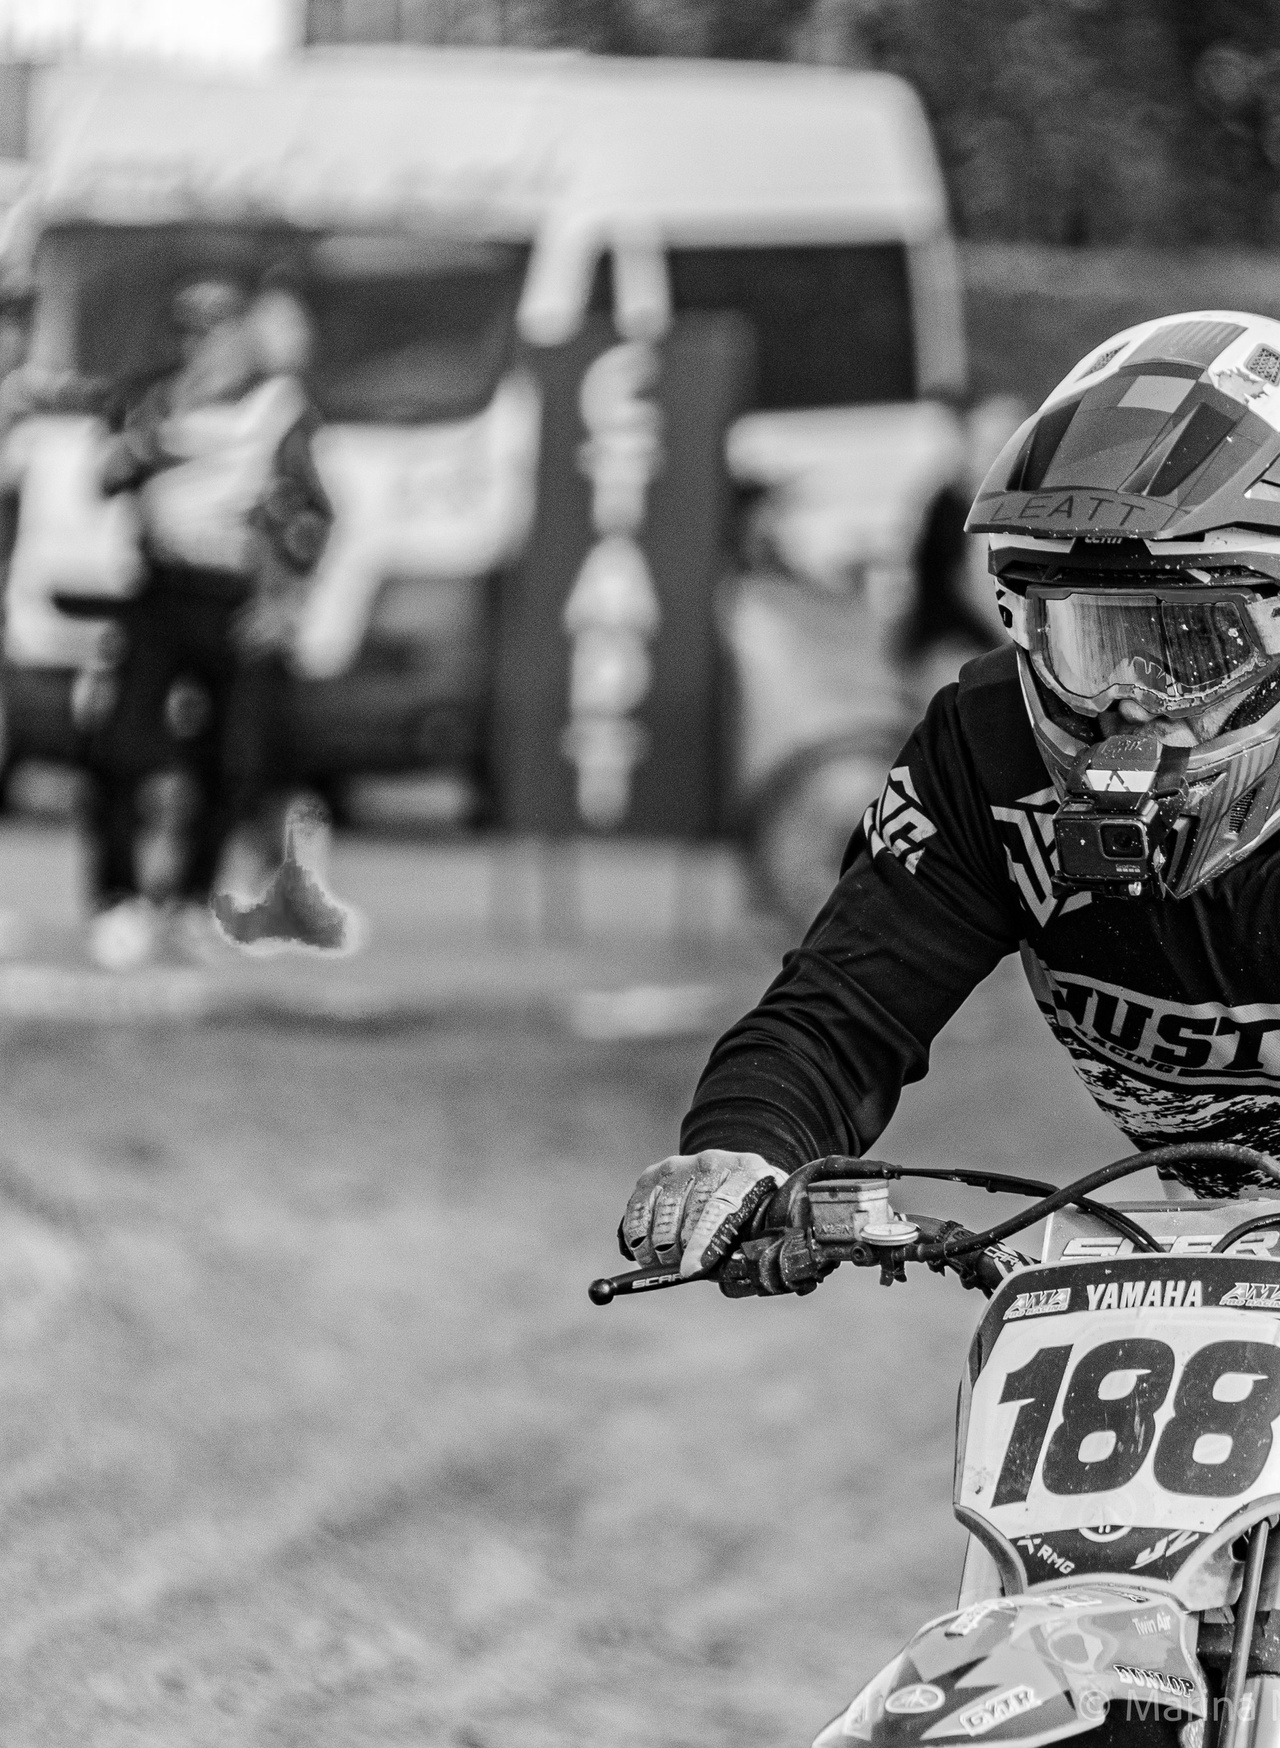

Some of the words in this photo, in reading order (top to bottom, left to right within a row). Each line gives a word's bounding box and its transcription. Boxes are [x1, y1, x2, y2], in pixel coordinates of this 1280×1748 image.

[989, 495, 1146, 527] LEATT
[982, 1245, 1020, 1267] CAR
[1087, 1280, 1203, 1311] YAMAHA
[1037, 1543, 1075, 1574] RMG
[1131, 1615, 1158, 1636] Twin
[1156, 1611, 1171, 1632] Air
[1113, 1664, 1195, 1698] DUNLOP
